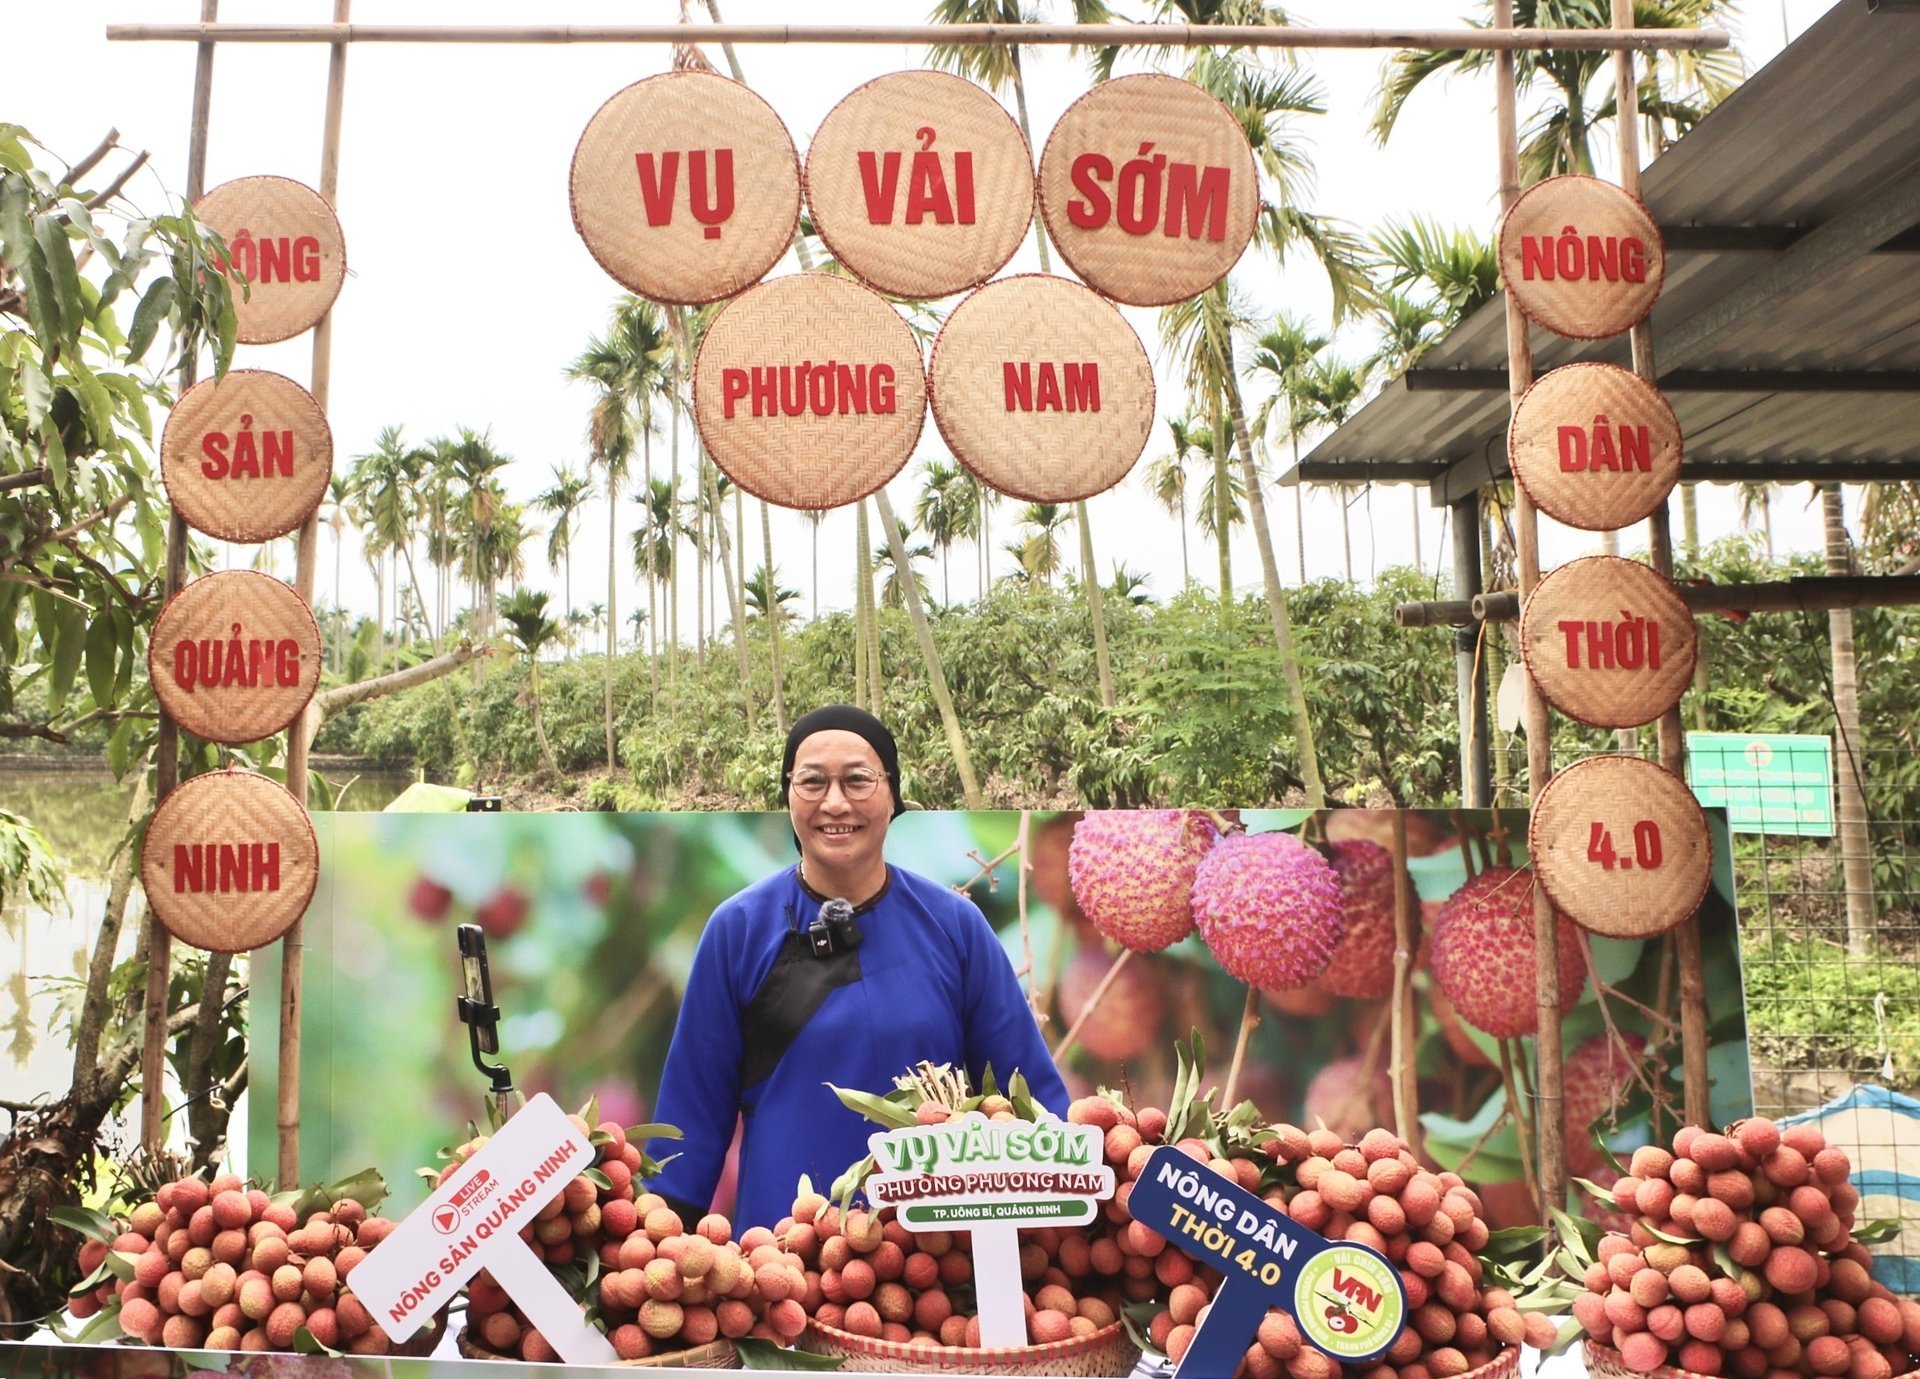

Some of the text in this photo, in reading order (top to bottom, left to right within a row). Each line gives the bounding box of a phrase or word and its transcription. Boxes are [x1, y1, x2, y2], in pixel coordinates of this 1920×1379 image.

[636, 127, 1231, 242] VỤ VẢI SỚM
[1521, 225, 1646, 284] NÔNG
[722, 360, 1101, 420] PHƯƠNG NAM
[202, 414, 295, 480] SẢN
[1558, 415, 1653, 472] DÂN
[174, 622, 300, 693] QUẢNG
[1559, 610, 1662, 671] THỜI
[174, 842, 281, 894] NINH
[1587, 820, 1663, 870] 4.0
[878, 1120, 1095, 1174] VỤ VẢI SỚM
[459, 1175, 482, 1199] LIVE
[461, 1179, 501, 1217] STREAM
[996, 1205, 1034, 1218] QUẢNG
[1035, 1205, 1062, 1216] NINH
[1058, 1173, 1106, 1193] NAM
[1157, 1162, 1298, 1261] NÔNG DÂN
[388, 1139, 579, 1324] NÔNG SẢN QUẢNG NINH
[1168, 1203, 1282, 1286] THỜI 4.0
[1332, 1267, 1383, 1313] VPN
